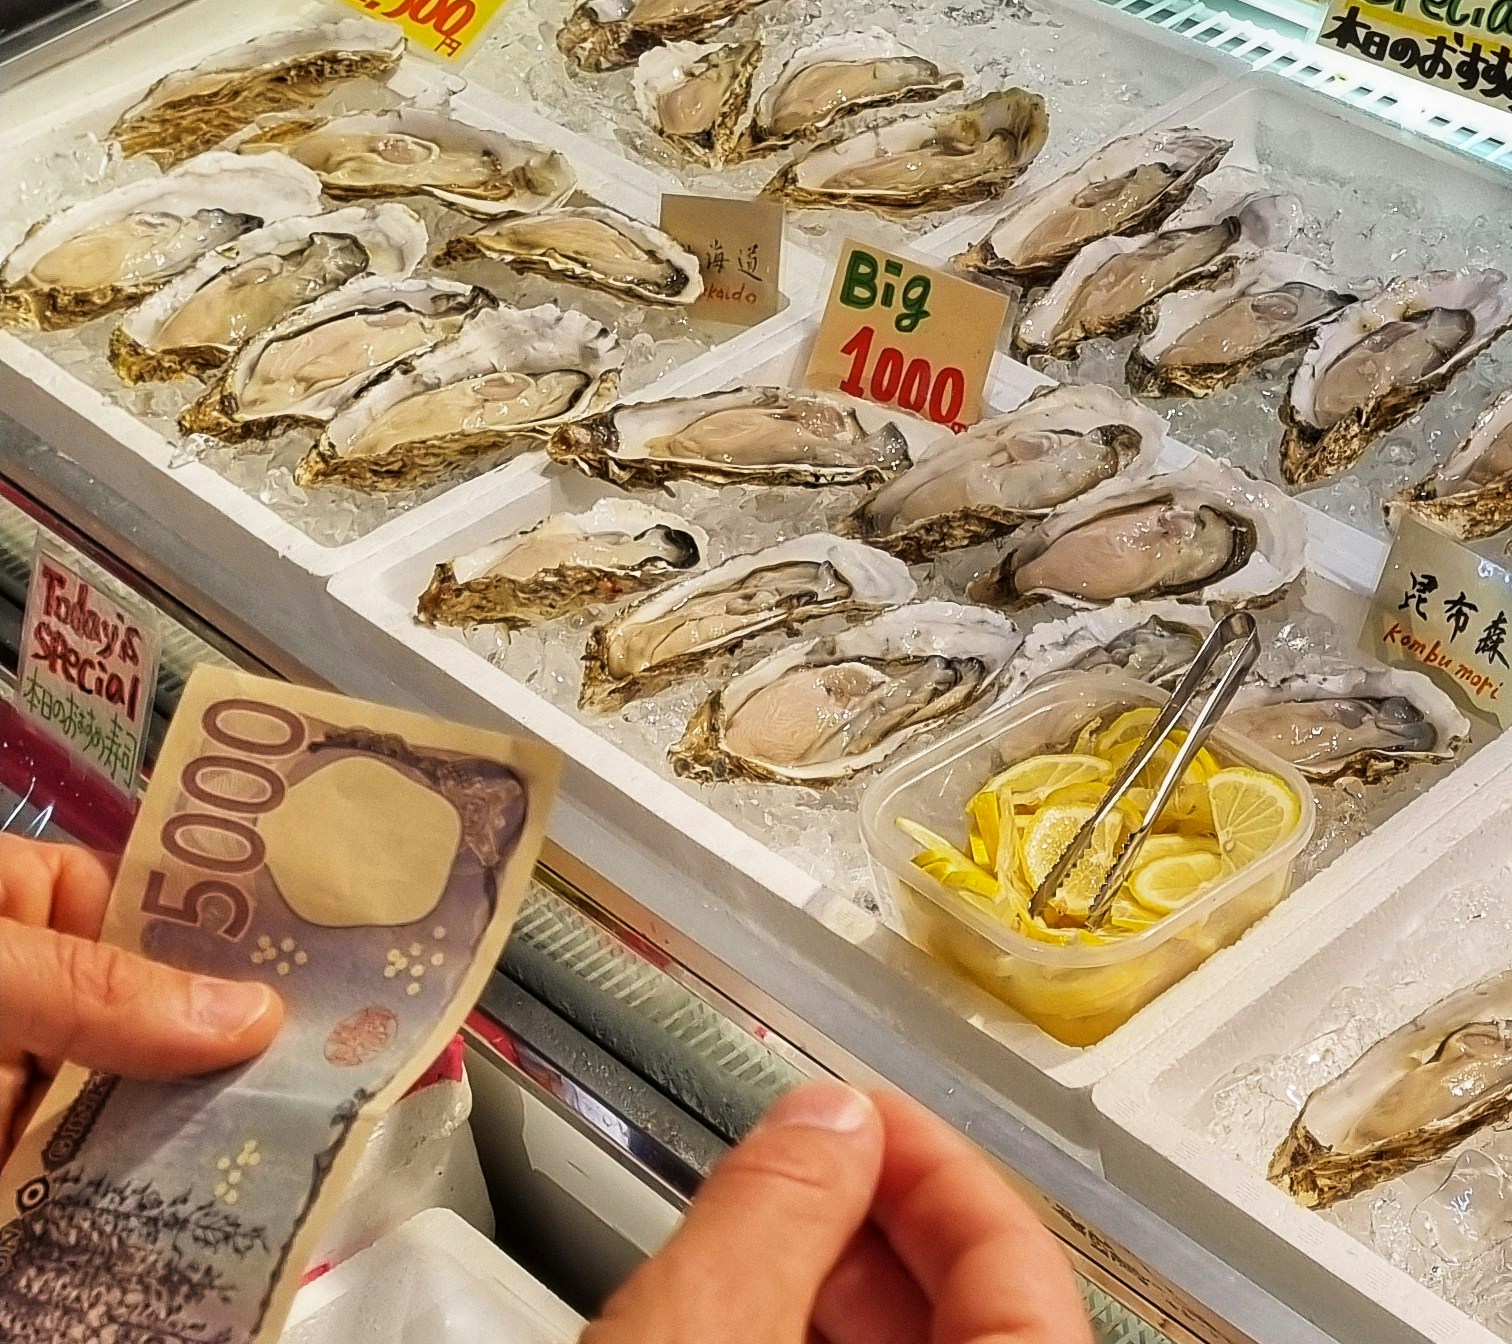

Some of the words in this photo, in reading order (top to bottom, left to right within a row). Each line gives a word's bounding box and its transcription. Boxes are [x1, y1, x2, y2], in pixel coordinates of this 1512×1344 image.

[702, 282, 757, 304] kaido
[840, 249, 932, 333] Big
[1398, 570, 1511, 670] 昆布森
[141, 699, 308, 940] 5000
